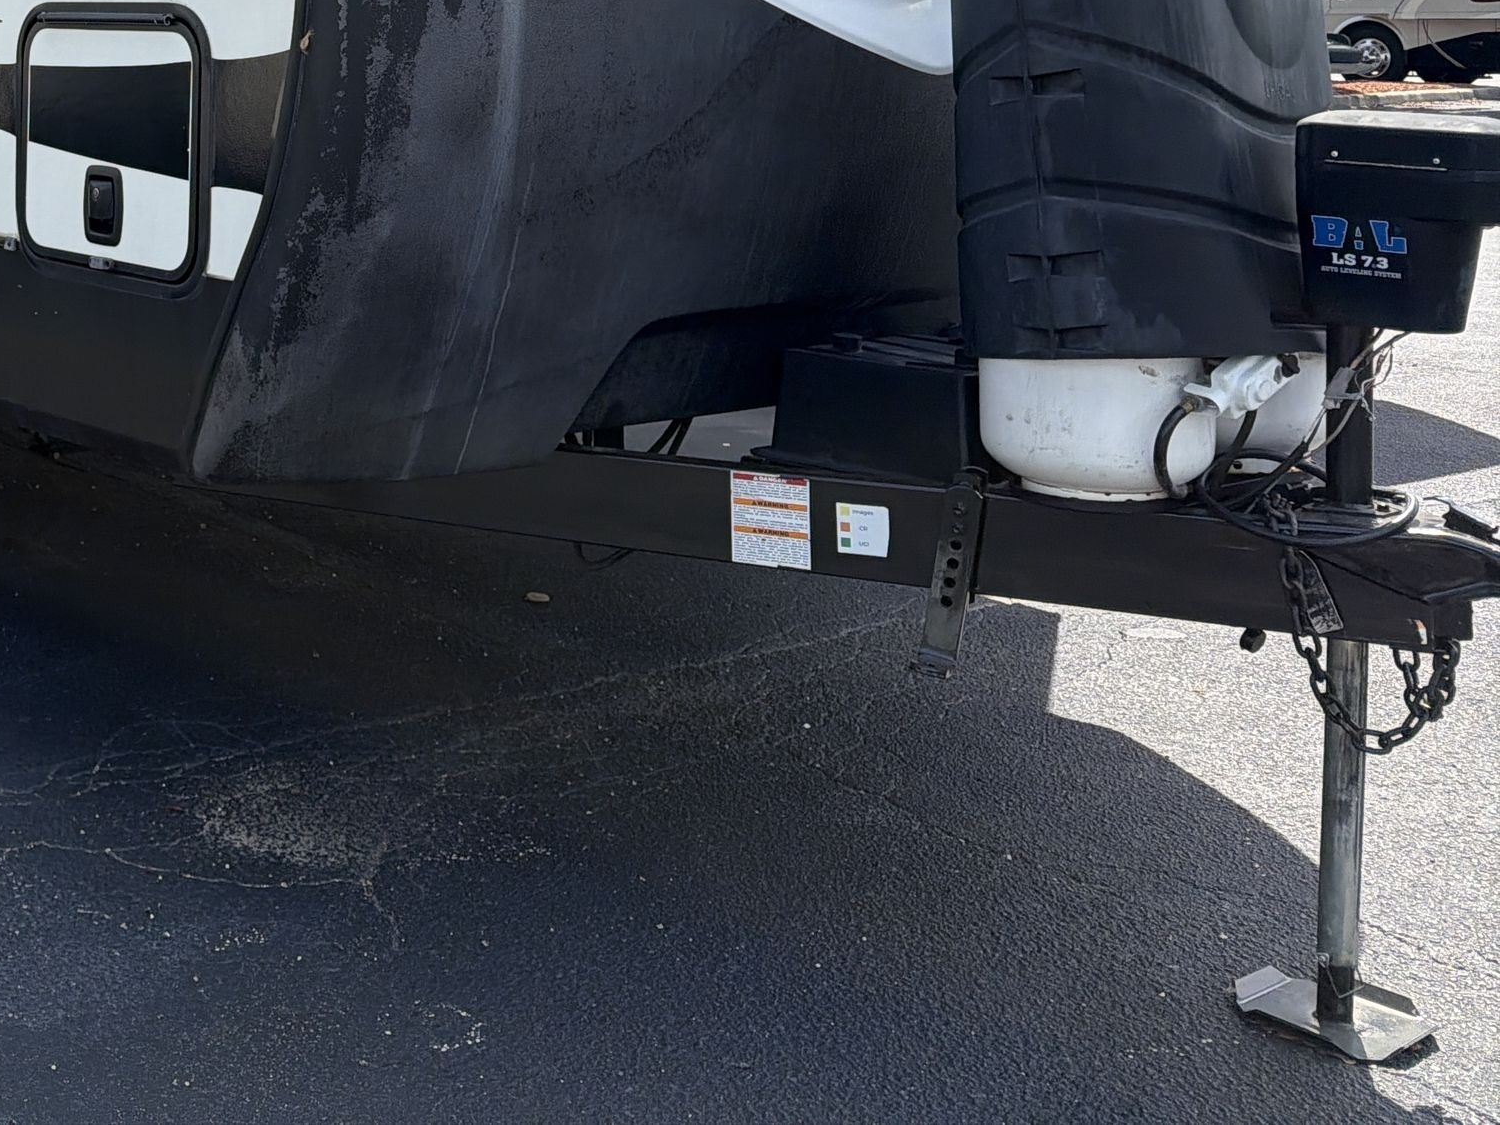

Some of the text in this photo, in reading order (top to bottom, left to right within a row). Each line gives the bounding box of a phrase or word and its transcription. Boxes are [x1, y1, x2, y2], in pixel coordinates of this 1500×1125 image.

[1311, 215, 1407, 254] BAL
[1331, 252, 1357, 266] LS
[1321, 265, 1402, 279] AUTO LEVELING SYSTEM
[756, 500, 789, 509] WARNING
[757, 528, 790, 537] WARNING
